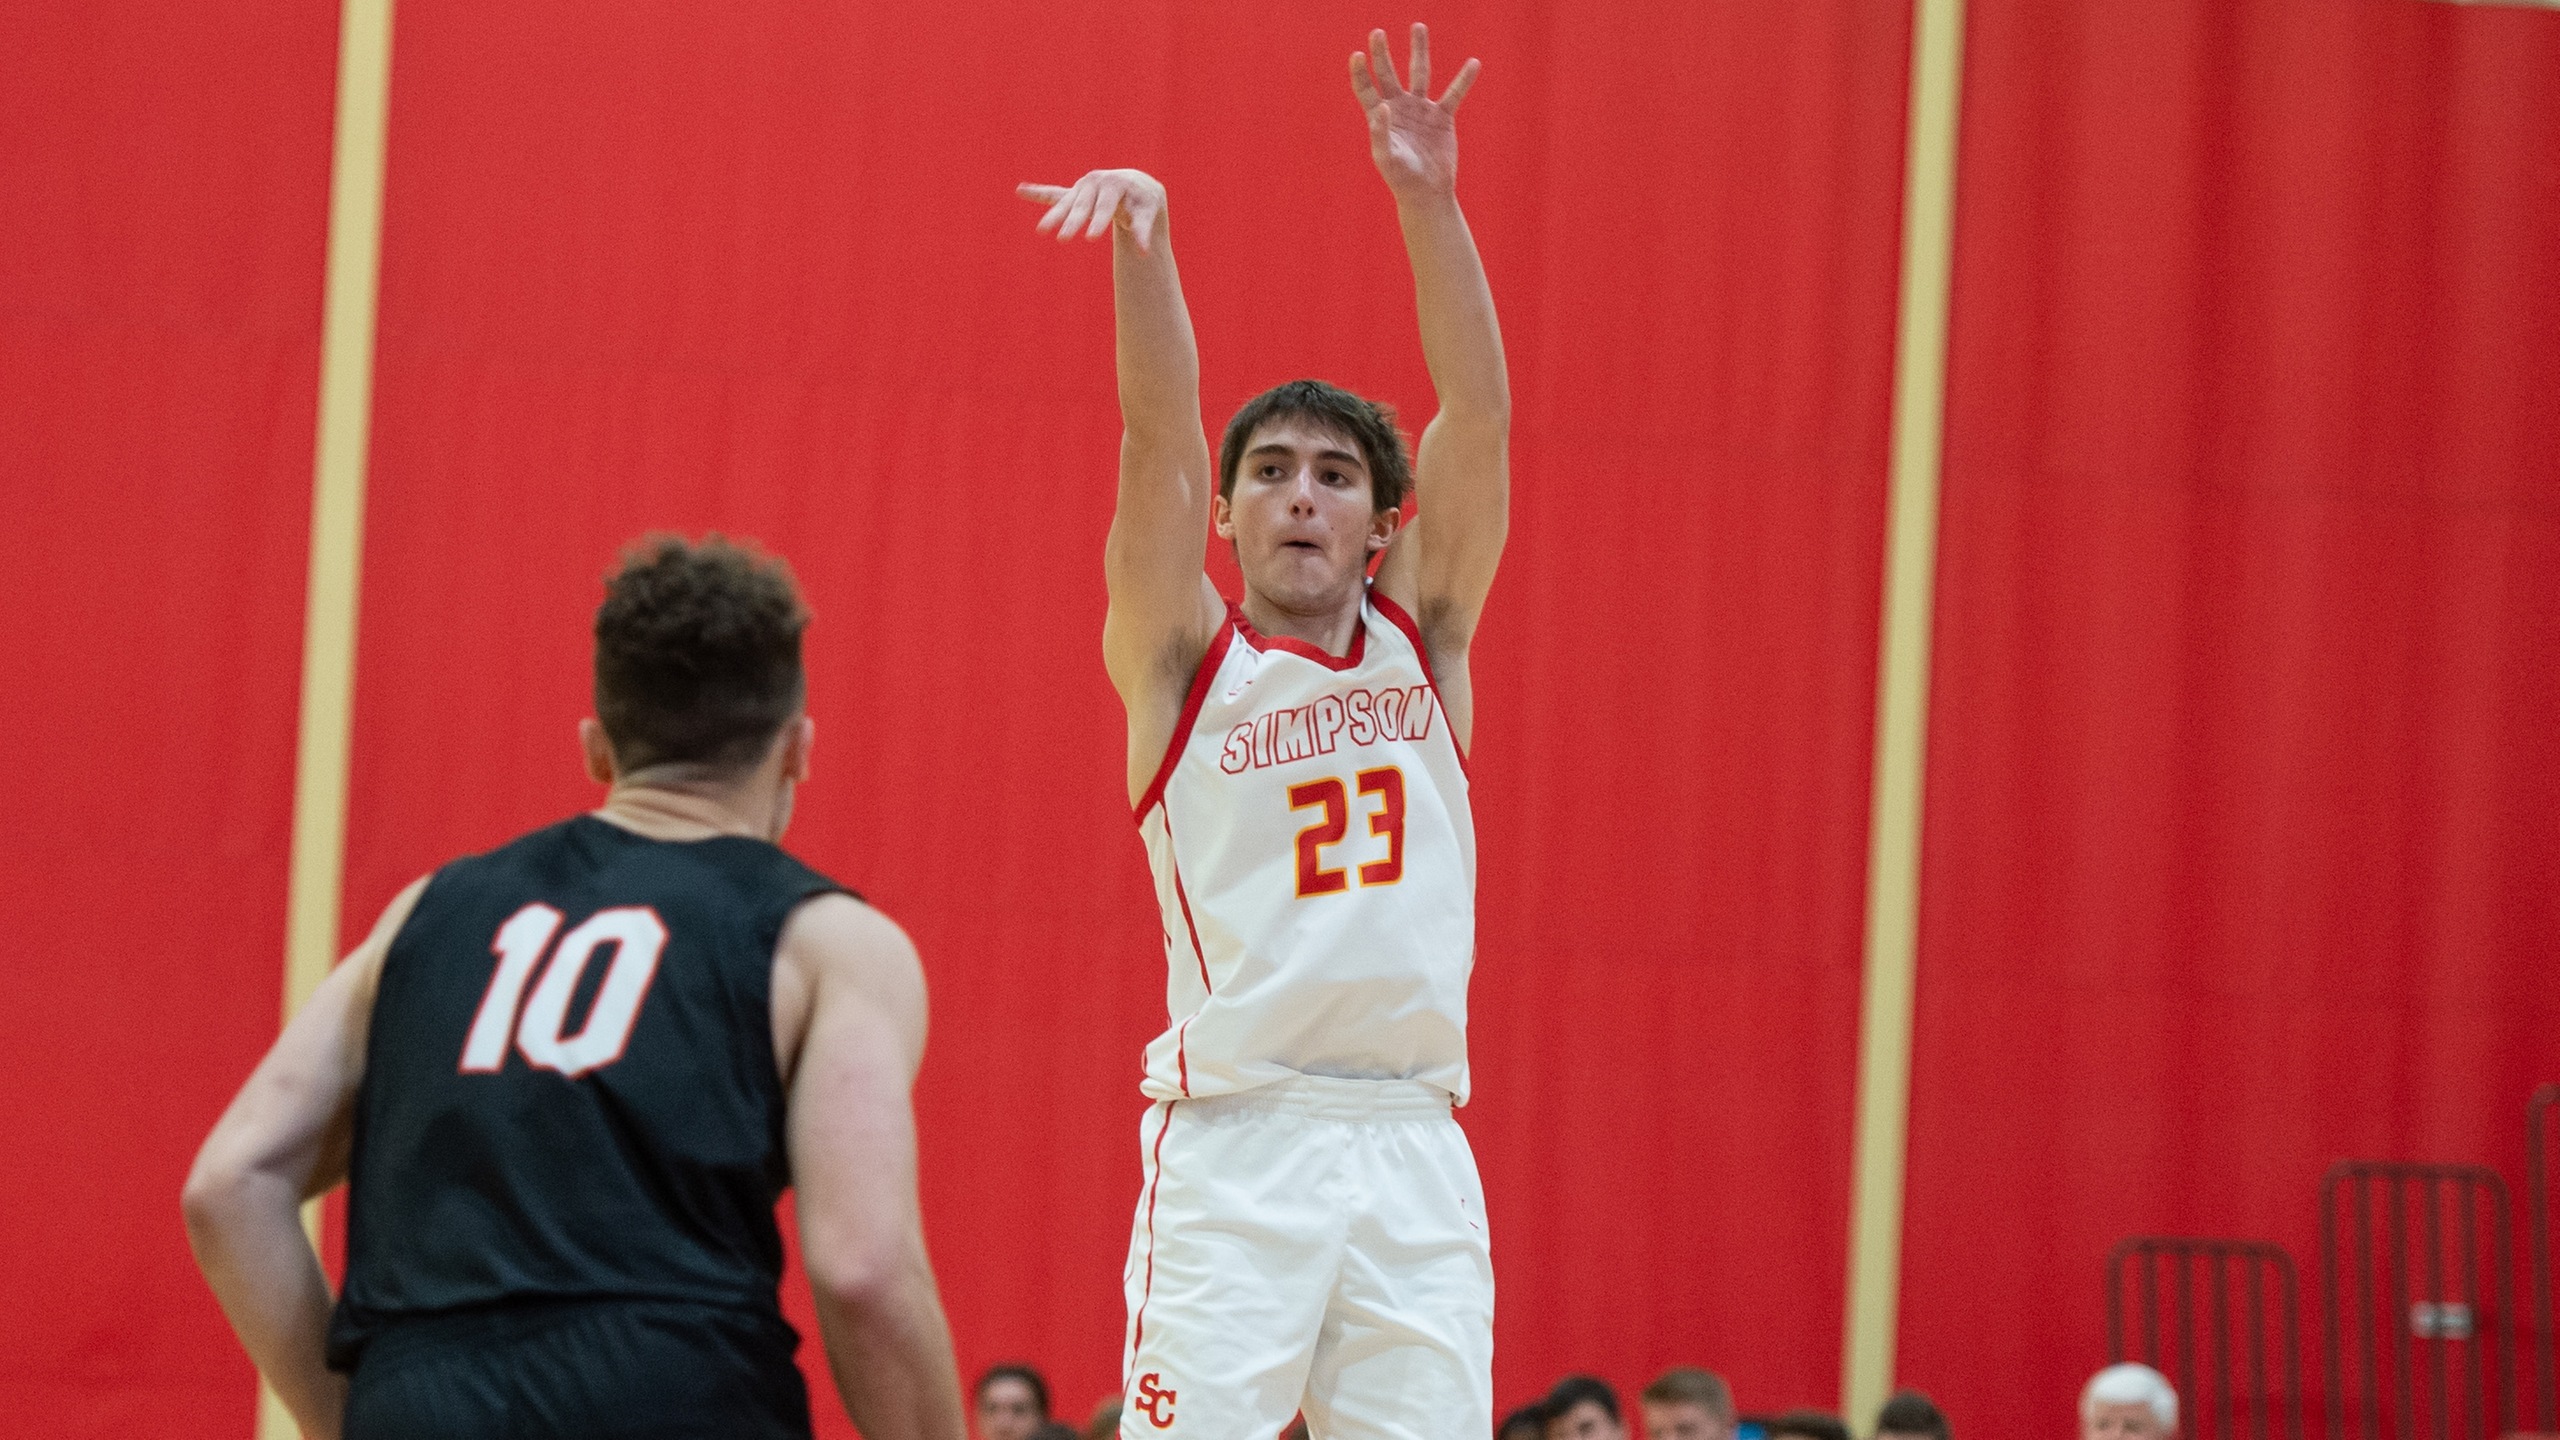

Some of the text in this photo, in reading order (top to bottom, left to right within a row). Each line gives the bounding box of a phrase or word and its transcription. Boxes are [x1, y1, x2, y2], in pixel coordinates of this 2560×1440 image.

[1220, 684, 1435, 775] SIMPSON
[1286, 765, 1407, 900] 23
[457, 900, 671, 1081] 10
[1135, 1372, 1177, 1430] SC
